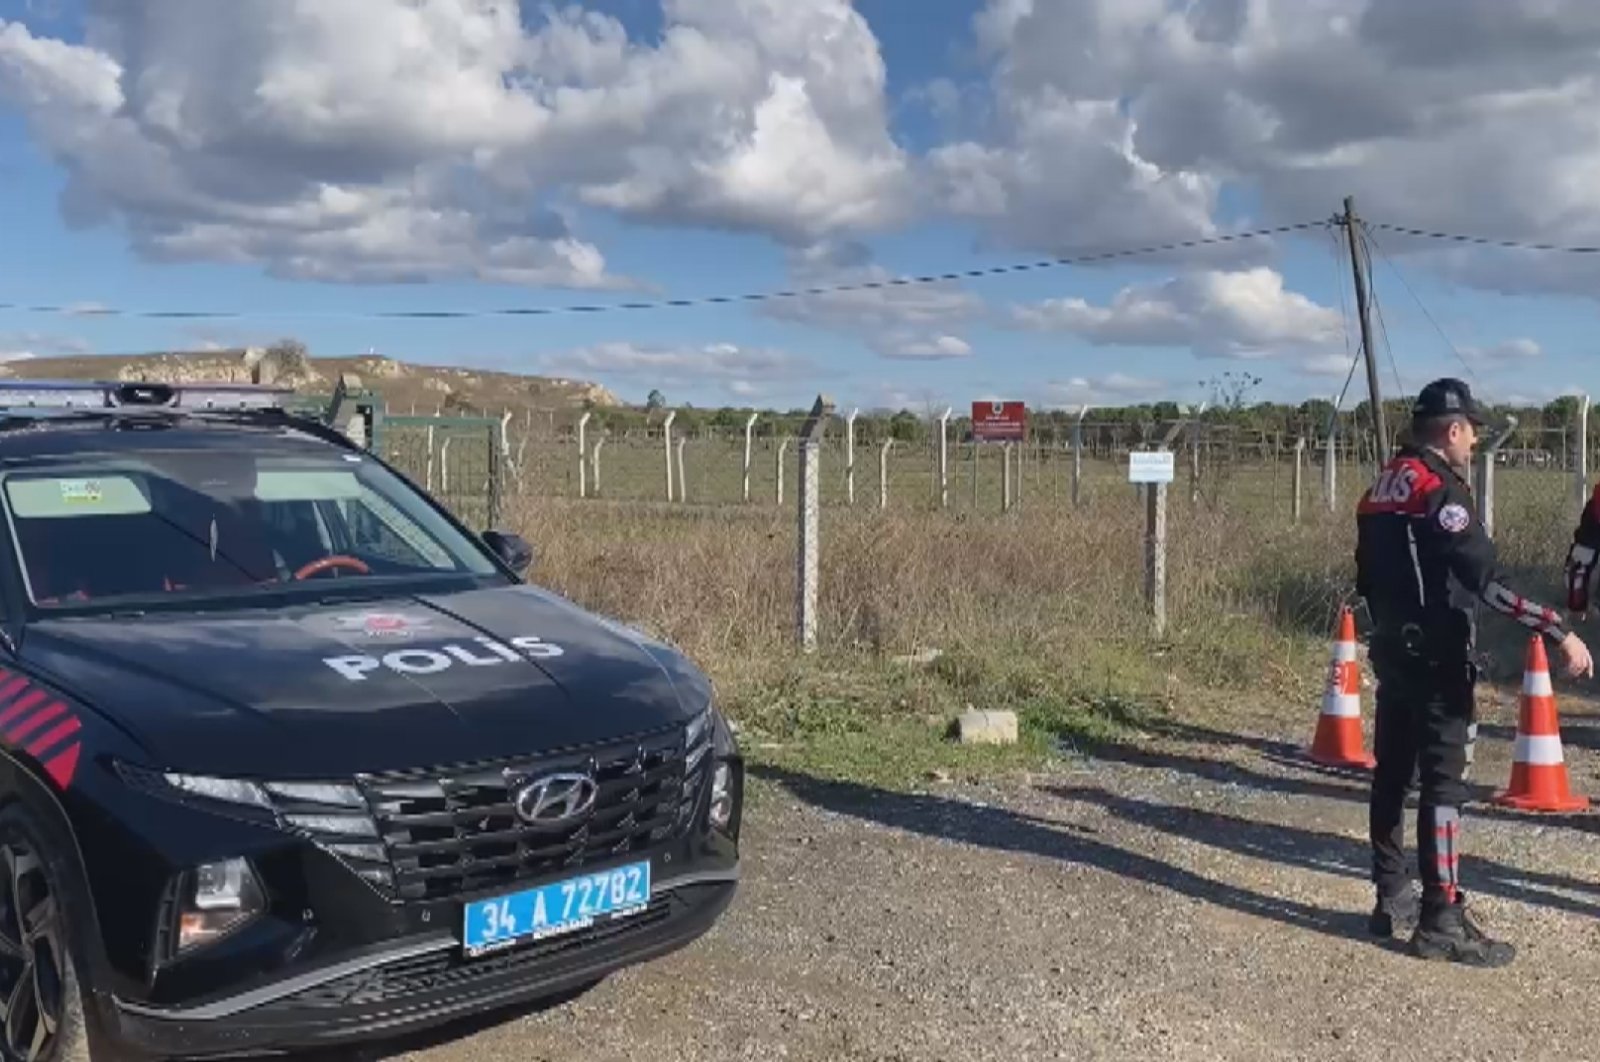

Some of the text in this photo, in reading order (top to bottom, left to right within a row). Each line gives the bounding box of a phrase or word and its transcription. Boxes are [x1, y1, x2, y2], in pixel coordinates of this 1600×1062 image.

[322, 635, 564, 681] POLİS
[481, 900, 517, 938] 34
[532, 890, 548, 927] A
[561, 867, 642, 919] 72782
